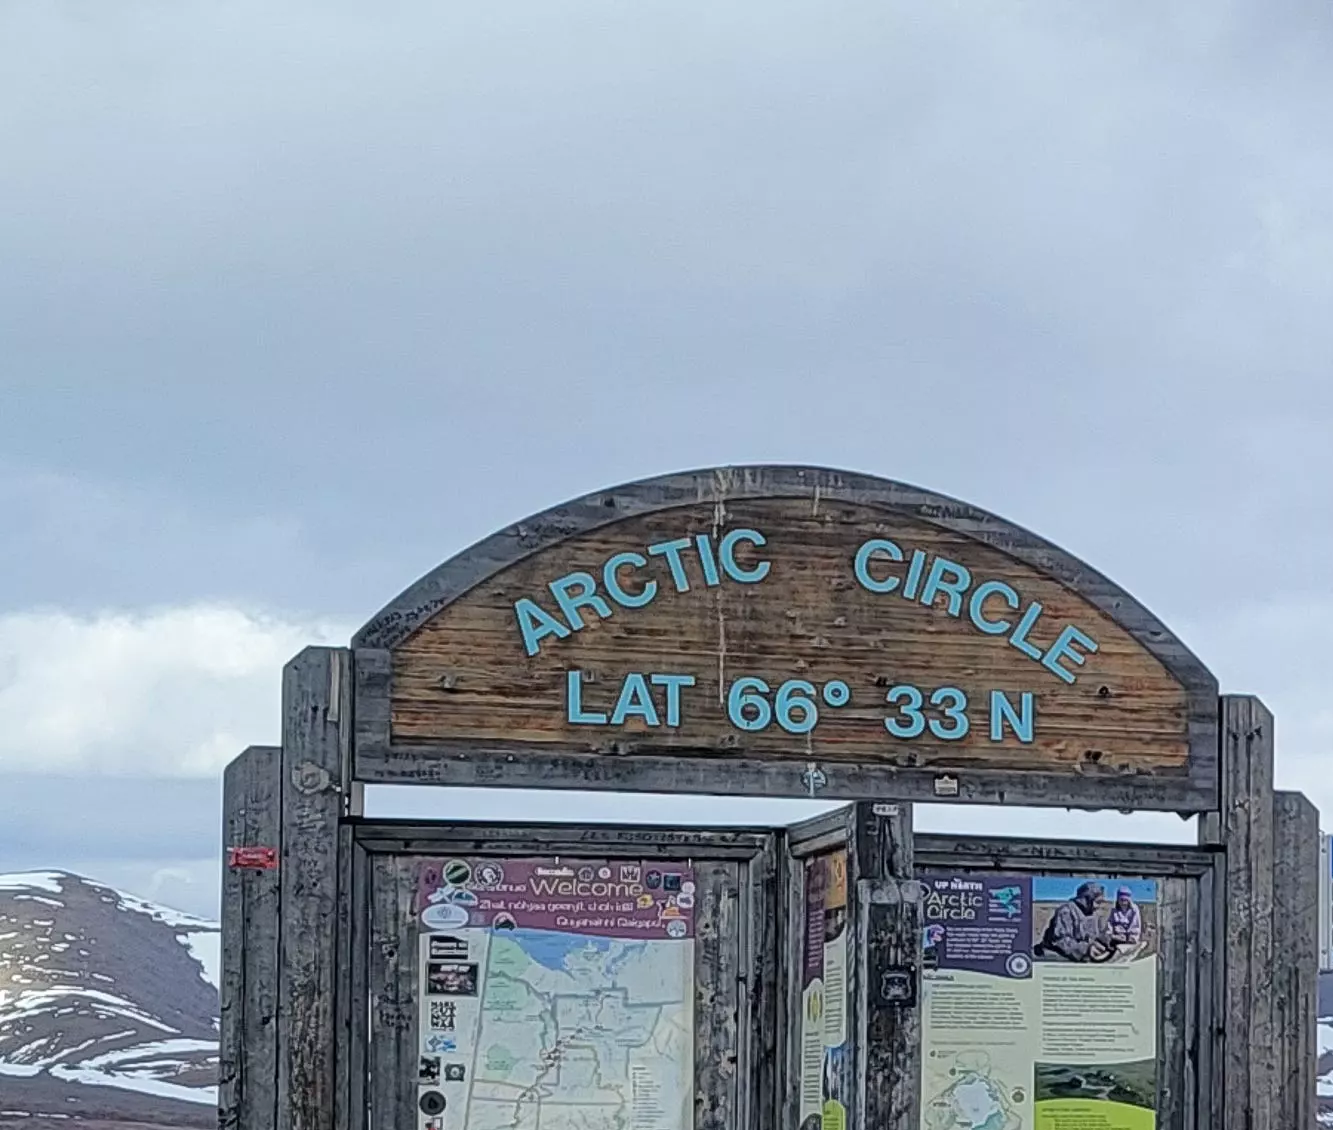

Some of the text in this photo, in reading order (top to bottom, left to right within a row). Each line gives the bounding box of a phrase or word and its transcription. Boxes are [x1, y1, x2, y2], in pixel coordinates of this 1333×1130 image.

[514, 528, 1099, 685] ARCTIC CIRCLE
[567, 670, 1035, 743] LAT 66° 33 N
[529, 877, 643, 898] Welcome
[934, 880, 949, 890] UP
[927, 891, 983, 907] Arctic
[926, 904, 976, 920] Circle
